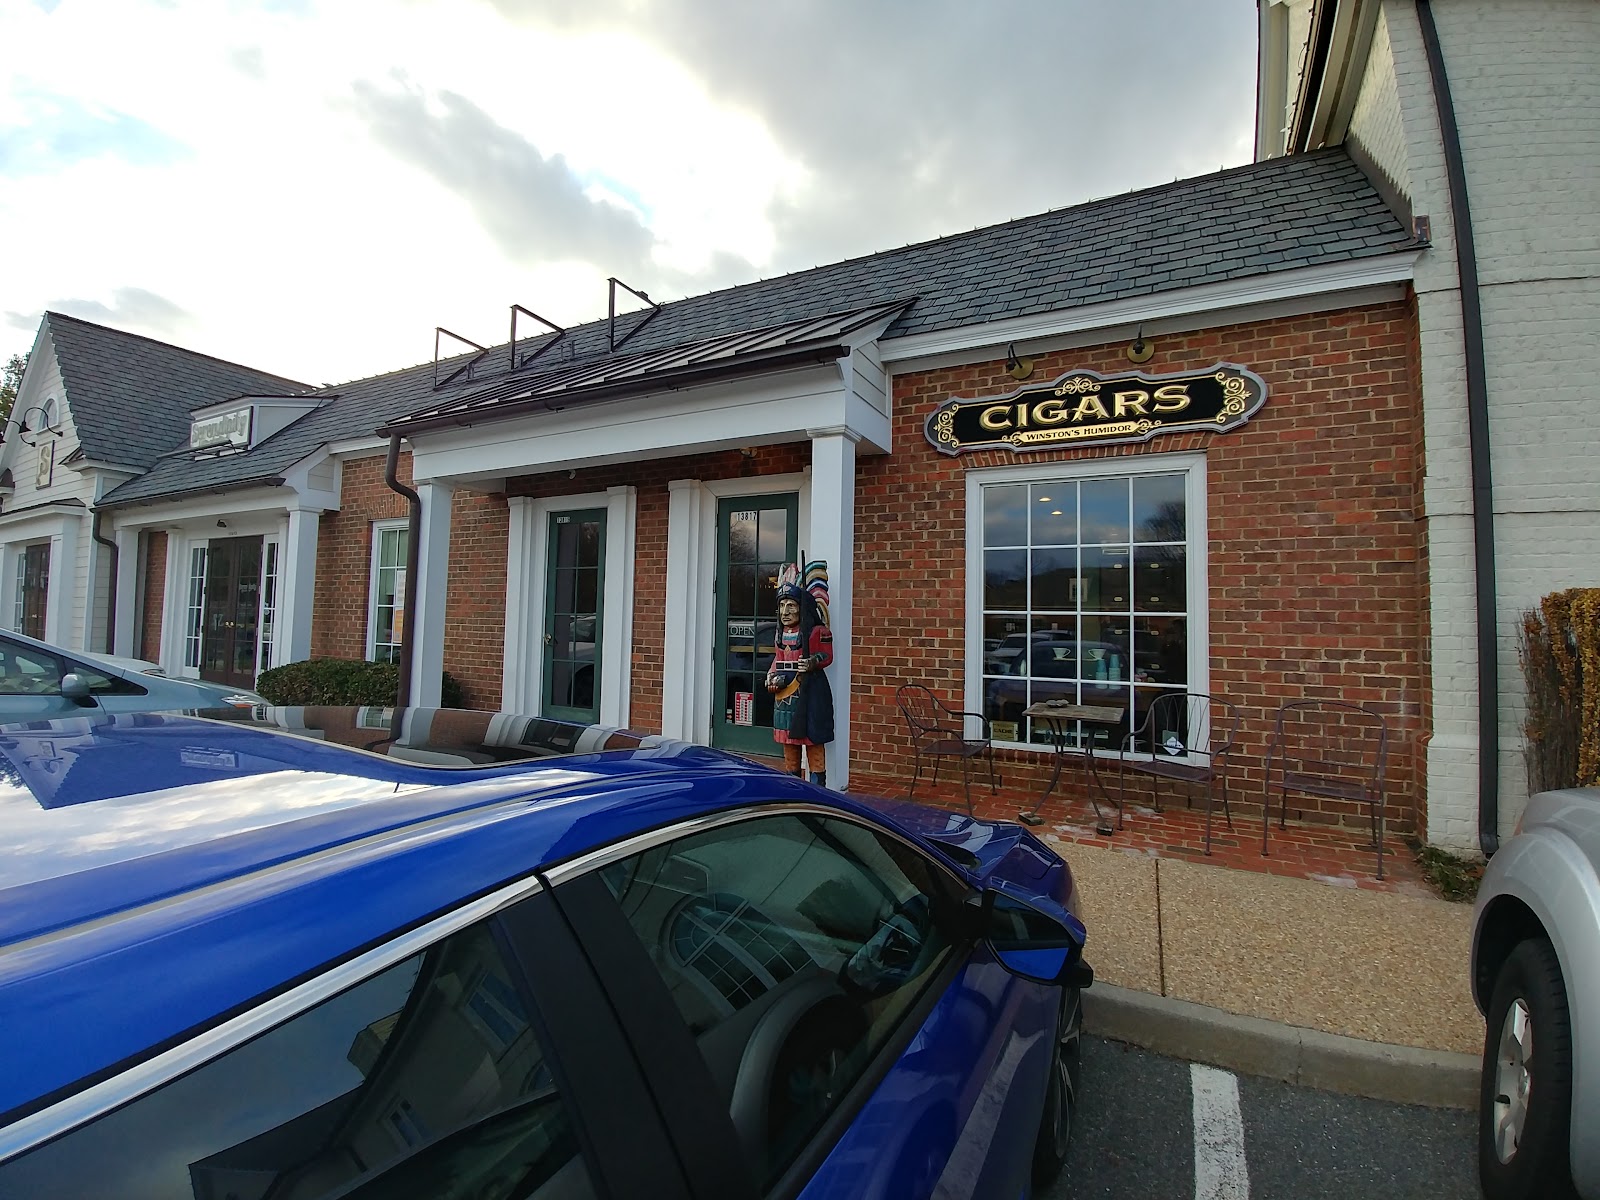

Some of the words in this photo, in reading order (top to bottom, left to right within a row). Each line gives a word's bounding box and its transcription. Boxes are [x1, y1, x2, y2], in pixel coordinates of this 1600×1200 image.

[980, 385, 1191, 431] CIGARS
[1027, 429, 1080, 441] WINSTON'S
[1084, 425, 1131, 434] HUMIDOR
[737, 511, 756, 520] 13817
[730, 625, 755, 636] OPEN
